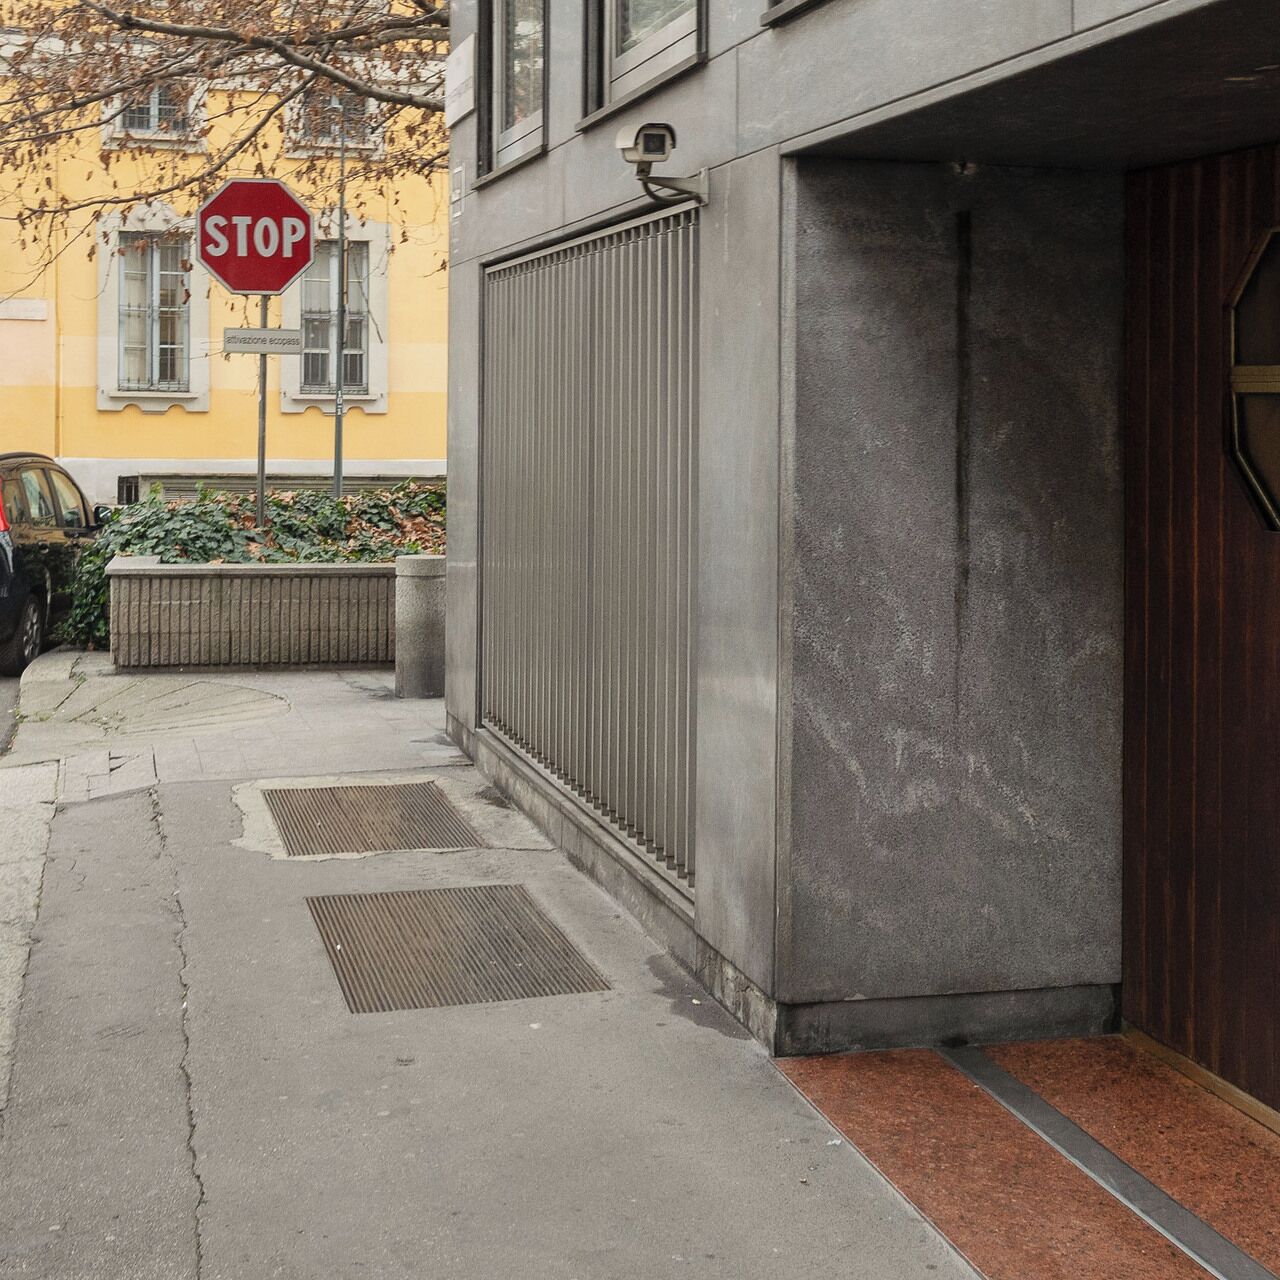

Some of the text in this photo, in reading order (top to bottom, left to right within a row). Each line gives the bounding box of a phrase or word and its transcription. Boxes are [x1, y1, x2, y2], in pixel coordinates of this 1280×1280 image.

[204, 214, 306, 258] STOP
[225, 334, 300, 347] attivazione ecopass
